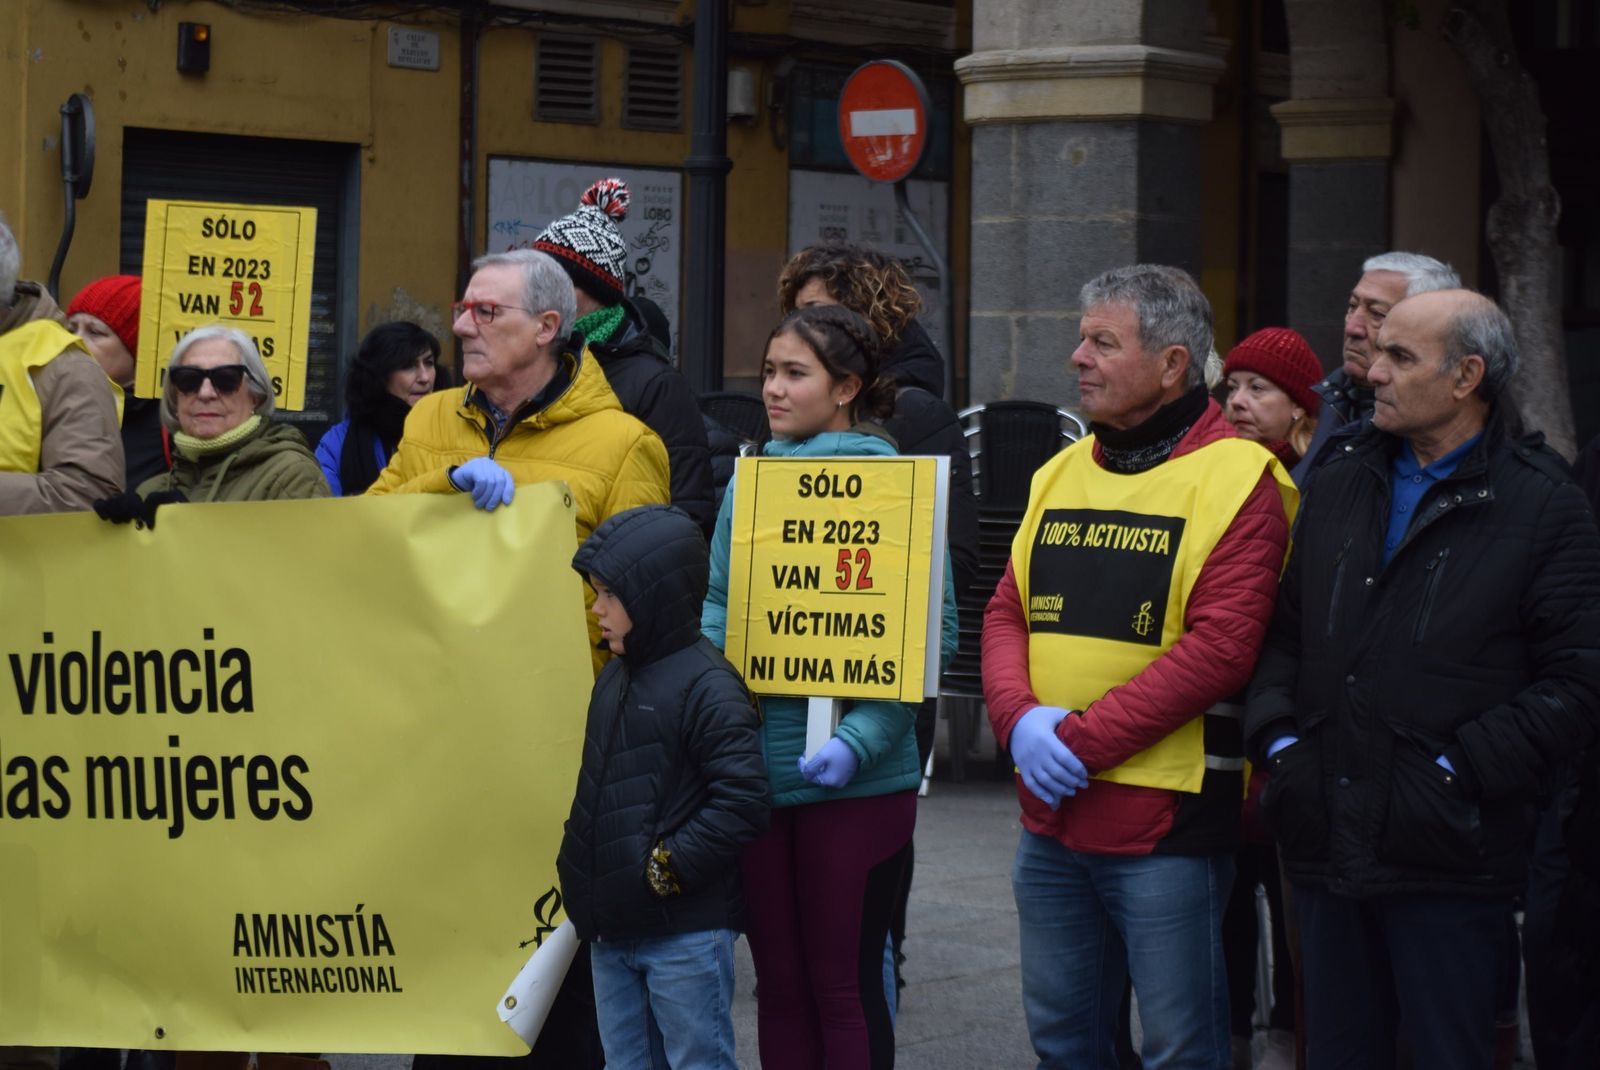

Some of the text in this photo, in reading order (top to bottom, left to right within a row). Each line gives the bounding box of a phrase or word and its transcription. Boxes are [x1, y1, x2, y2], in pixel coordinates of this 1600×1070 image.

[202, 215, 256, 240] SÓLO
[643, 207, 672, 221] LOBO
[188, 255, 271, 280] EN 2023
[179, 281, 264, 317] VAN 52
[797, 468, 862, 498] SÓLO
[782, 519, 880, 545] EN 2023
[1040, 522, 1171, 556] 100% ACTIVISTA
[772, 547, 873, 591] VAN 52
[767, 605, 886, 638] VÍCTIMAS
[8, 627, 254, 716] violencia
[750, 654, 896, 686] NI UNA MÁS
[85, 735, 313, 839] mujeres
[233, 903, 396, 958] AMNISTÍA
[235, 966, 403, 994] INTERNACIONAL
